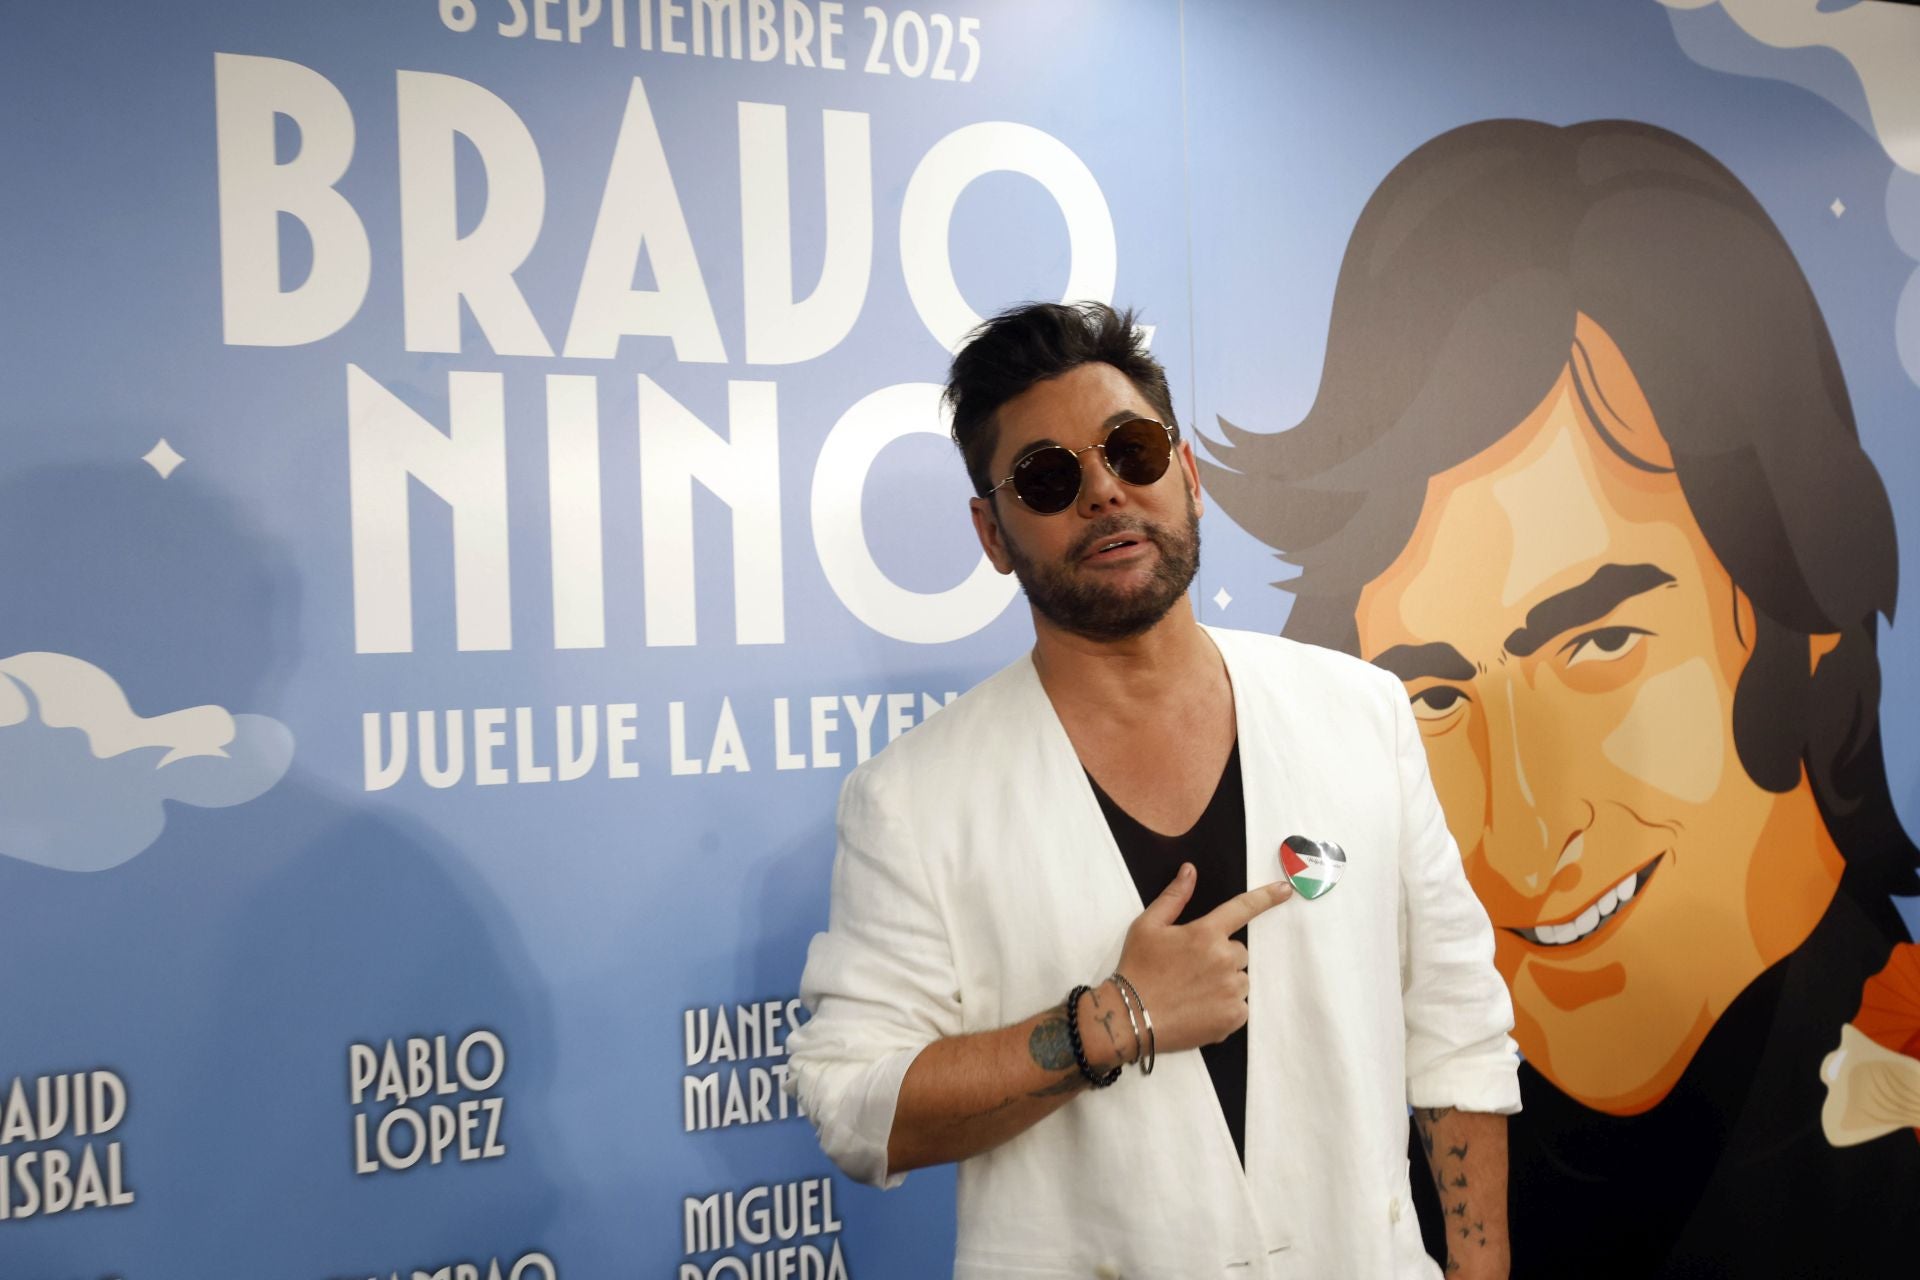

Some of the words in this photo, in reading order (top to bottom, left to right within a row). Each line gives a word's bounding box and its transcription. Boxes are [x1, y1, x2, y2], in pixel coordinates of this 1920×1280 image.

[497, 0, 847, 71] SEPTIEMBRE
[863, 6, 981, 83] 2025
[347, 363, 1021, 654] NINO
[362, 703, 640, 792] VUELVE
[668, 696, 751, 776] LA
[774, 691, 958, 770] LEYE
[350, 1030, 505, 1105] PABLO
[684, 1063, 806, 1132] MART
[0, 1070, 127, 1145] AVID
[355, 1094, 506, 1174] LÓPEZ
[684, 1177, 842, 1255] MIGUEL
